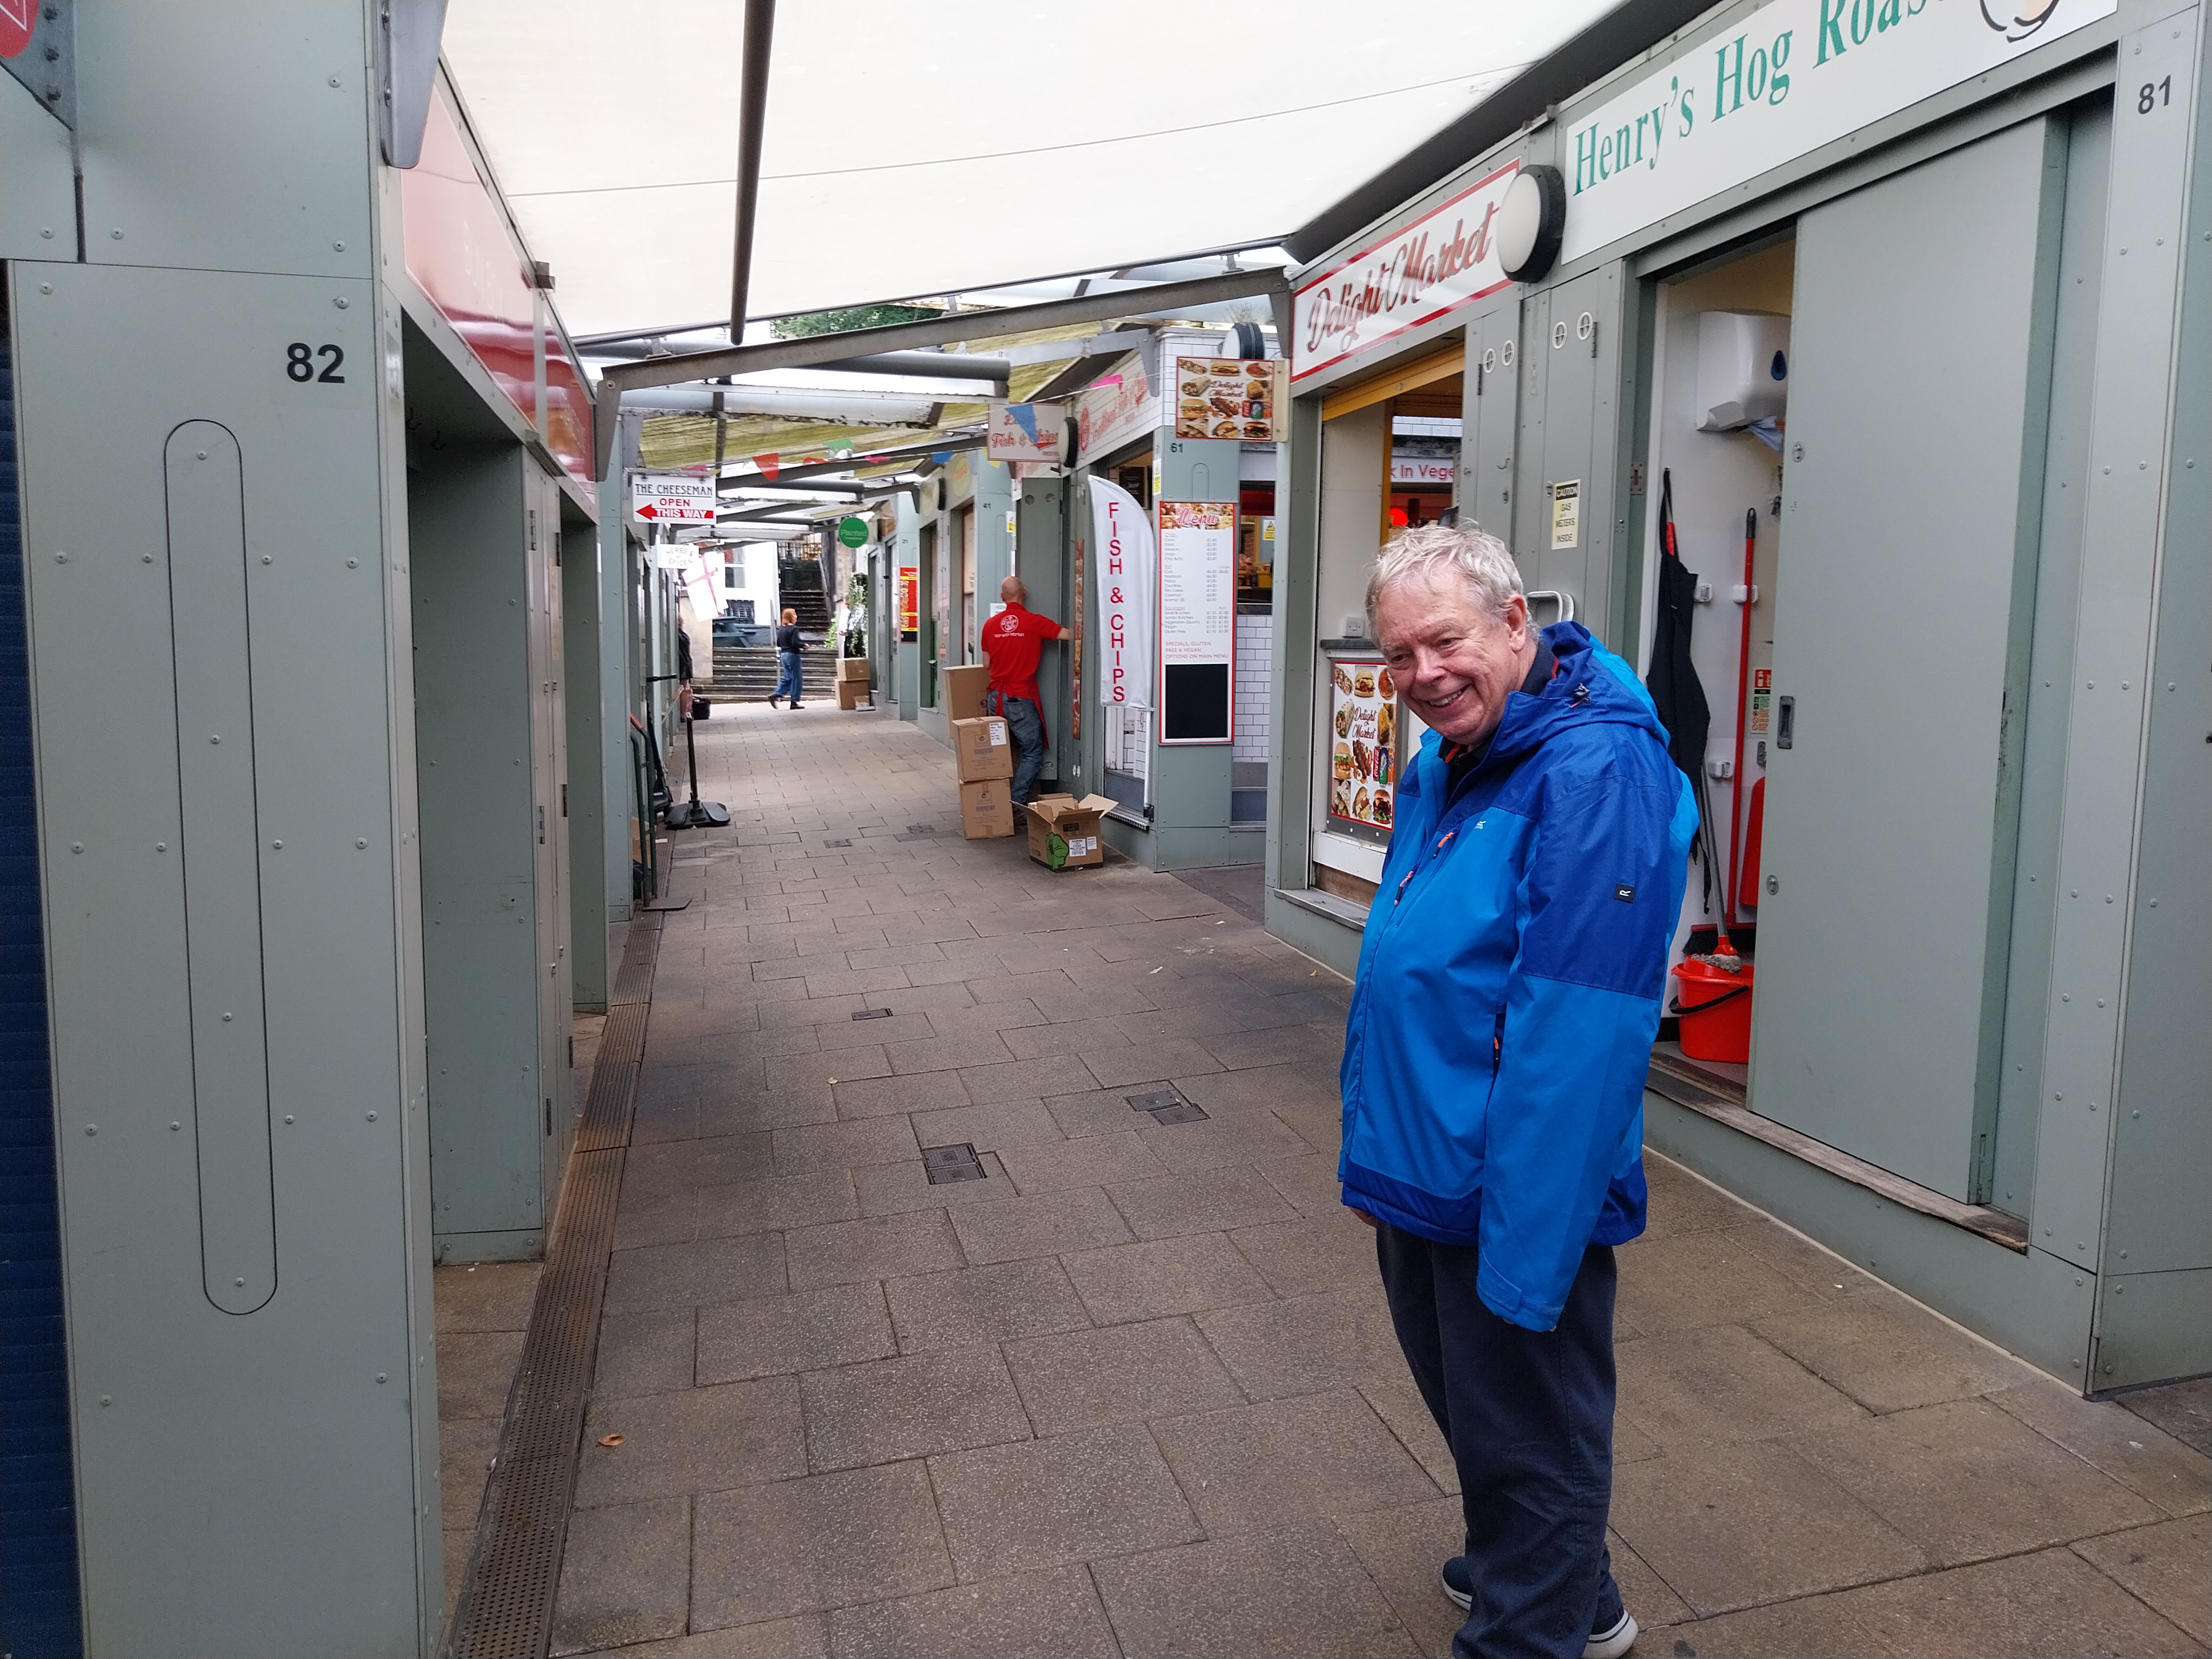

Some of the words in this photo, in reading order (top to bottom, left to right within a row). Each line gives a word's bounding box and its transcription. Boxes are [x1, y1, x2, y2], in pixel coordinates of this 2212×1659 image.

[2138, 74, 2171, 114] 81
[1574, 75, 1694, 196] Henry's
[1712, 30, 1793, 123] Hog
[1307, 262, 1390, 352] Delight
[1384, 201, 1500, 312] Market
[286, 342, 345, 384] 82
[1028, 428, 1059, 444] hips
[1170, 443, 1184, 453] 61
[1400, 465, 1413, 477] In
[635, 484, 653, 493] THE
[657, 485, 713, 496] CHEESEMAN
[1557, 487, 1578, 497] CAUTION
[659, 498, 691, 507] OPEN
[1561, 503, 1572, 511] GAS
[654, 509, 681, 517] THIS
[682, 510, 707, 518] WAY
[1175, 506, 1218, 525] Menu
[1556, 518, 1576, 528] METERS
[1108, 502, 1122, 575] FISH
[1557, 534, 1573, 543] INSIDE
[665, 547, 688, 555] HERBS
[1110, 587, 1124, 604] &
[1110, 614, 1126, 702] CHIPS
[1354, 707, 1377, 726] Delight
[1352, 724, 1377, 740] Market
